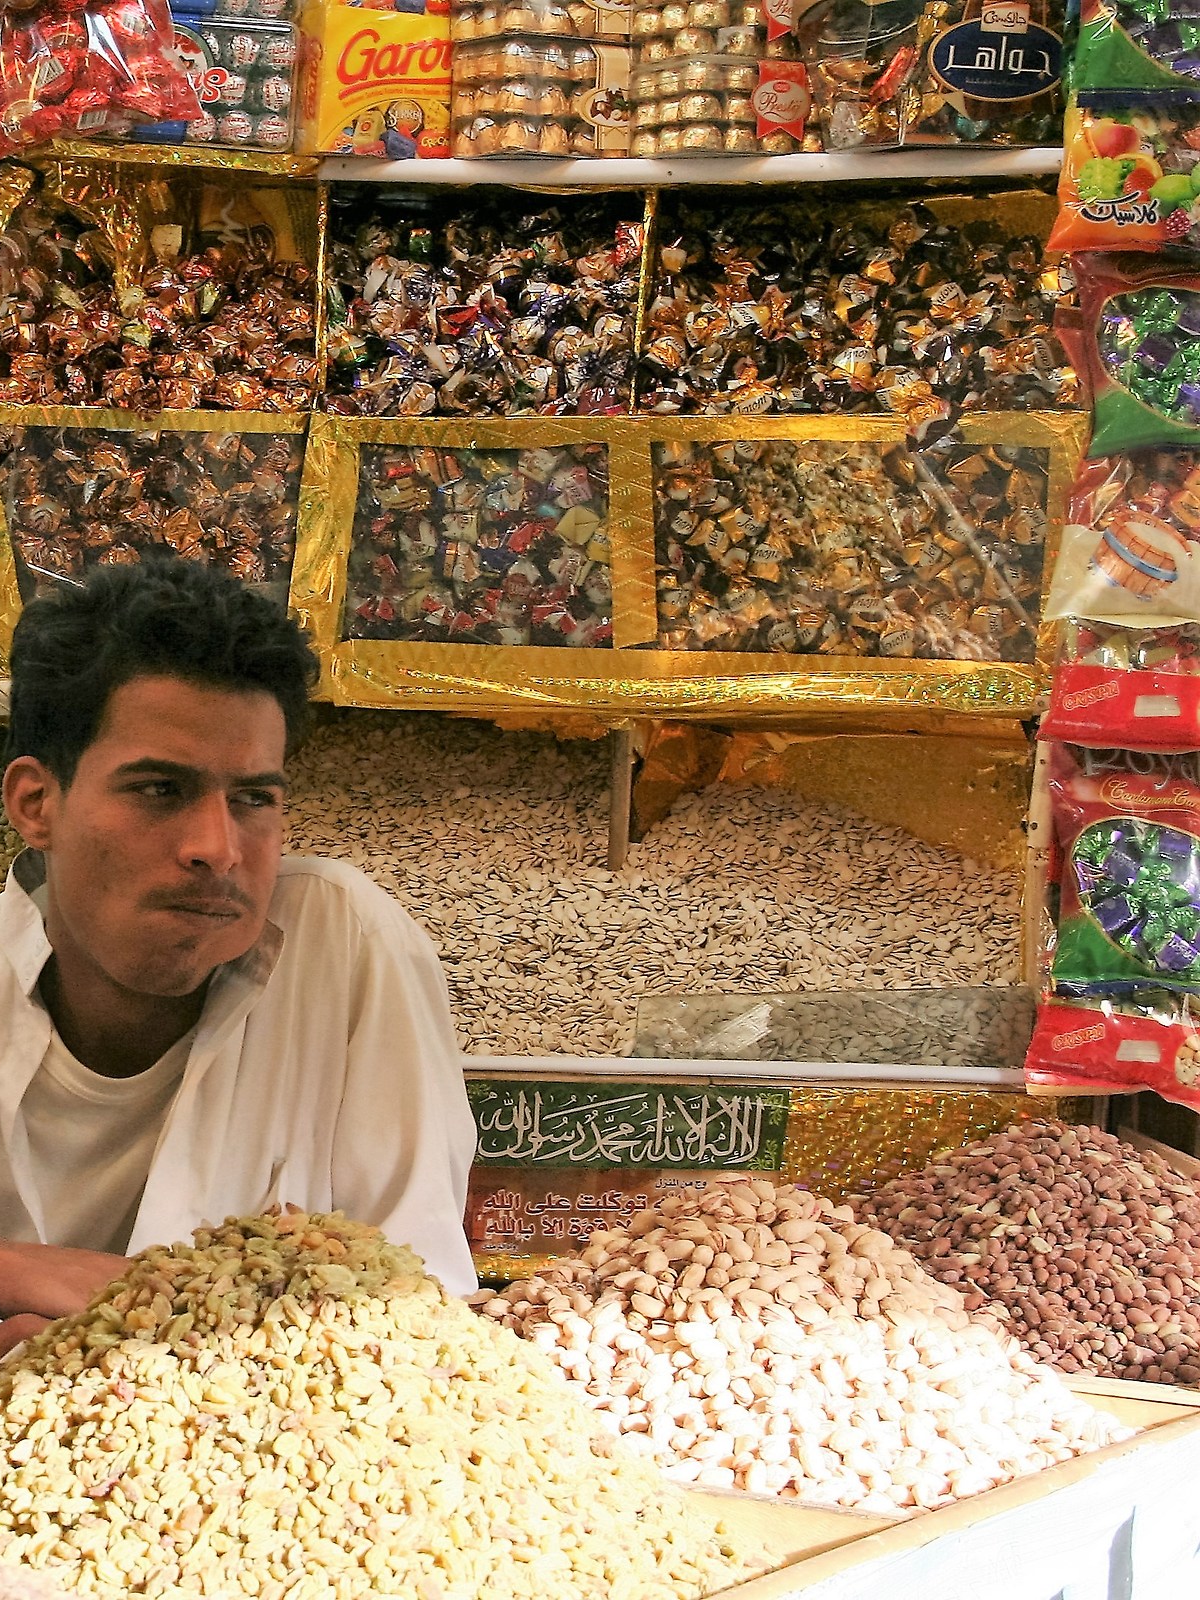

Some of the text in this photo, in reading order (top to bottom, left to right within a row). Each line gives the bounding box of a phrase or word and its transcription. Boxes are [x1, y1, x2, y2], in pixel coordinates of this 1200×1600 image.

[942, 36, 1053, 77] جواهر
[1080, 191, 1160, 226] كلاسيك
[569, 1112, 642, 1163] محمد
[629, 1093, 685, 1162] الله
[480, 1189, 520, 1213] الله
[524, 1192, 572, 1215] على
[484, 1215, 535, 1240] بالله
[541, 1215, 564, 1239] إلا
